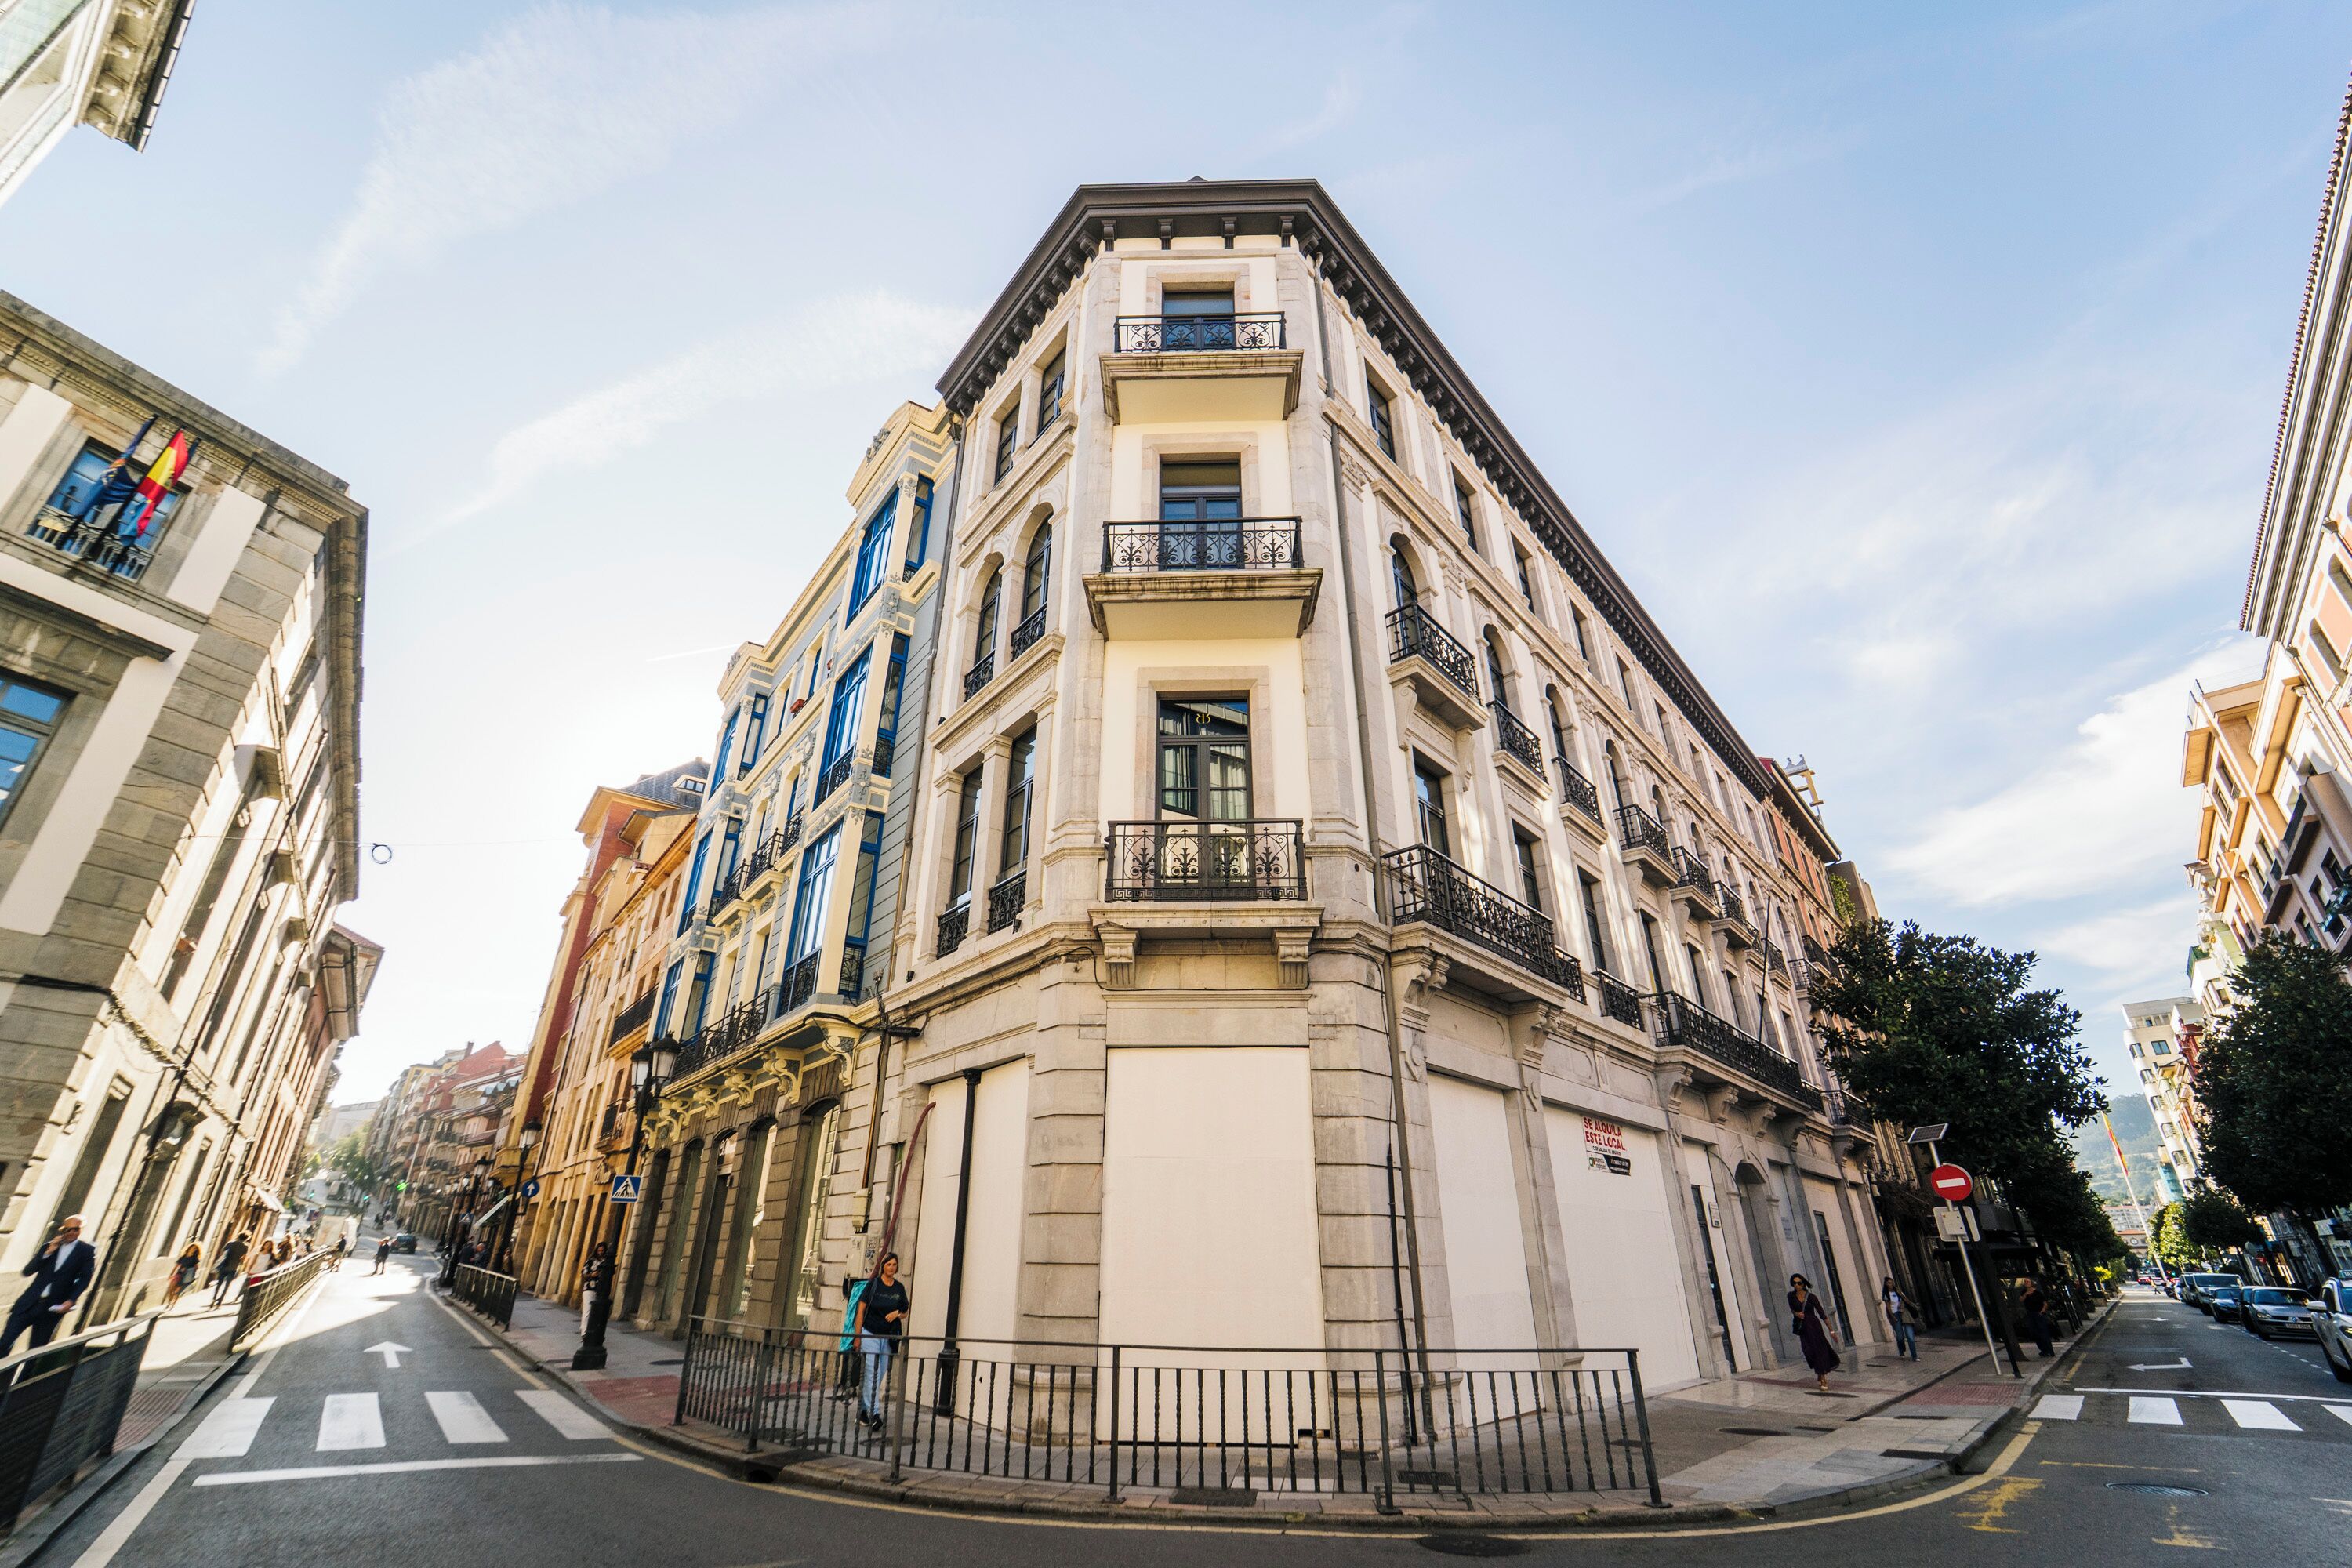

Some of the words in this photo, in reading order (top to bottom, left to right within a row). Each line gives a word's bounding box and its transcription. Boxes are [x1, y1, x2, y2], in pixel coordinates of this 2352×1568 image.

[1584, 1116, 1593, 1130] SE
[1595, 1120, 1622, 1137] ALQUILA
[1585, 1131, 1602, 1145] ESTE
[1603, 1135, 1626, 1150] LOCAL
